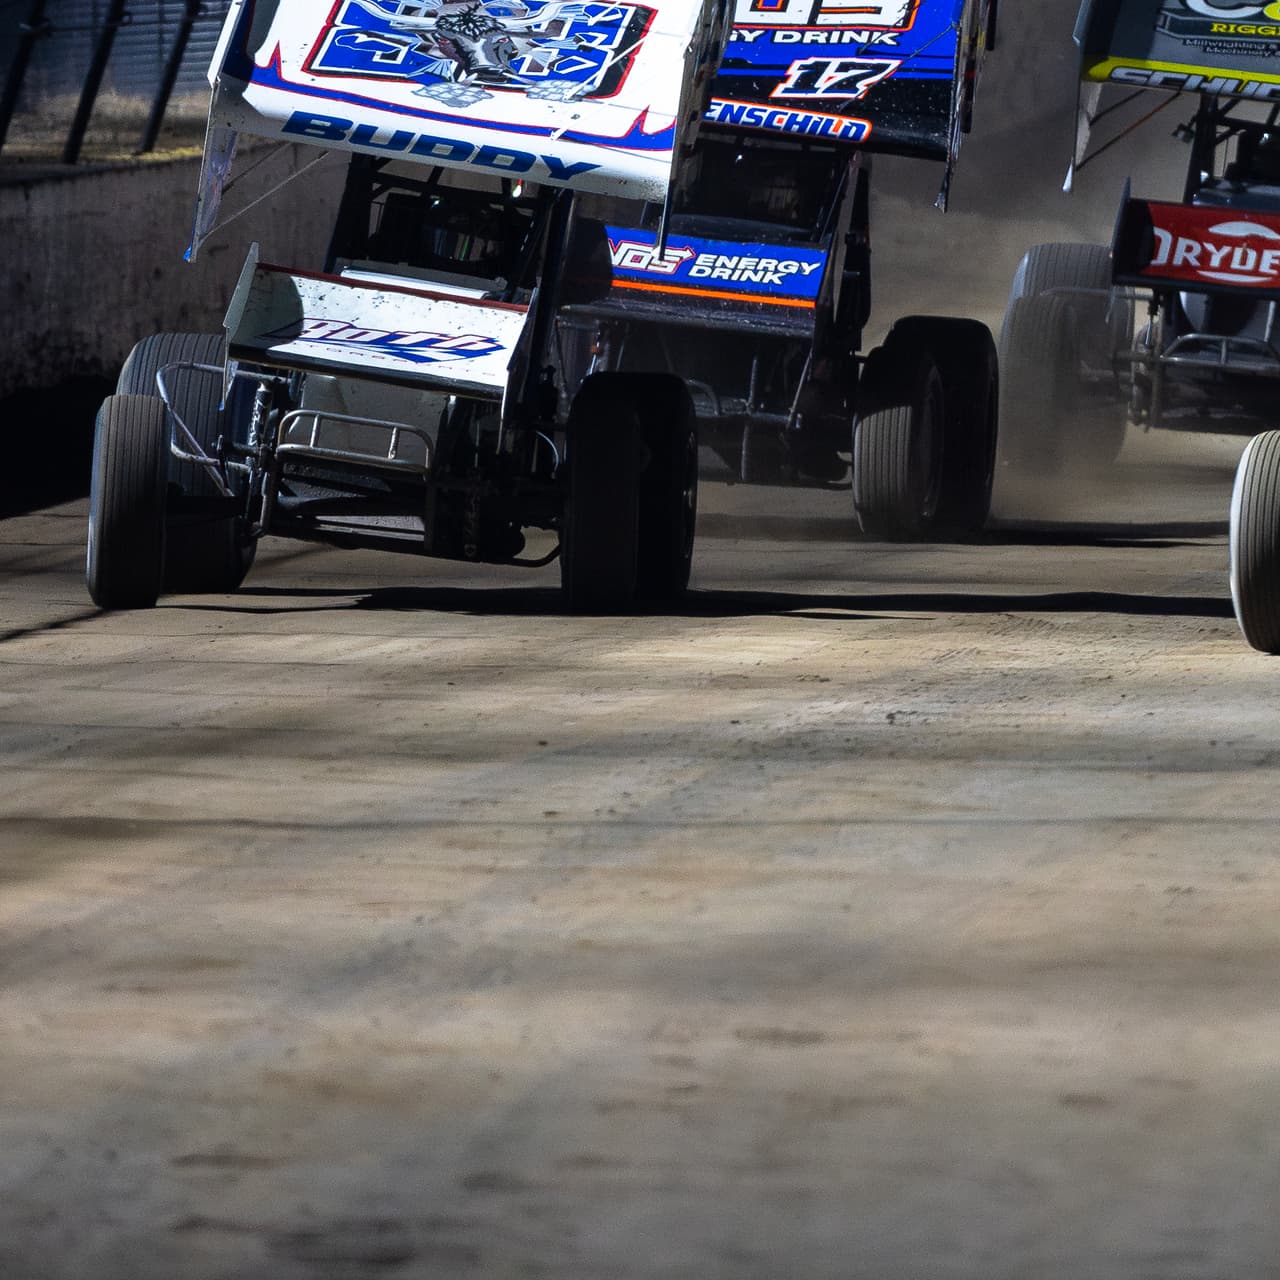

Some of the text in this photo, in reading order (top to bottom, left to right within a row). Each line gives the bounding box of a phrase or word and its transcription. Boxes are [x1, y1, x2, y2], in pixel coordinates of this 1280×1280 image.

[774, 30, 899, 46] DRINK
[773, 57, 902, 98] 17
[281, 110, 602, 181] BUDDY
[688, 265, 786, 285] DRINK
[695, 253, 821, 276] ENERGY
